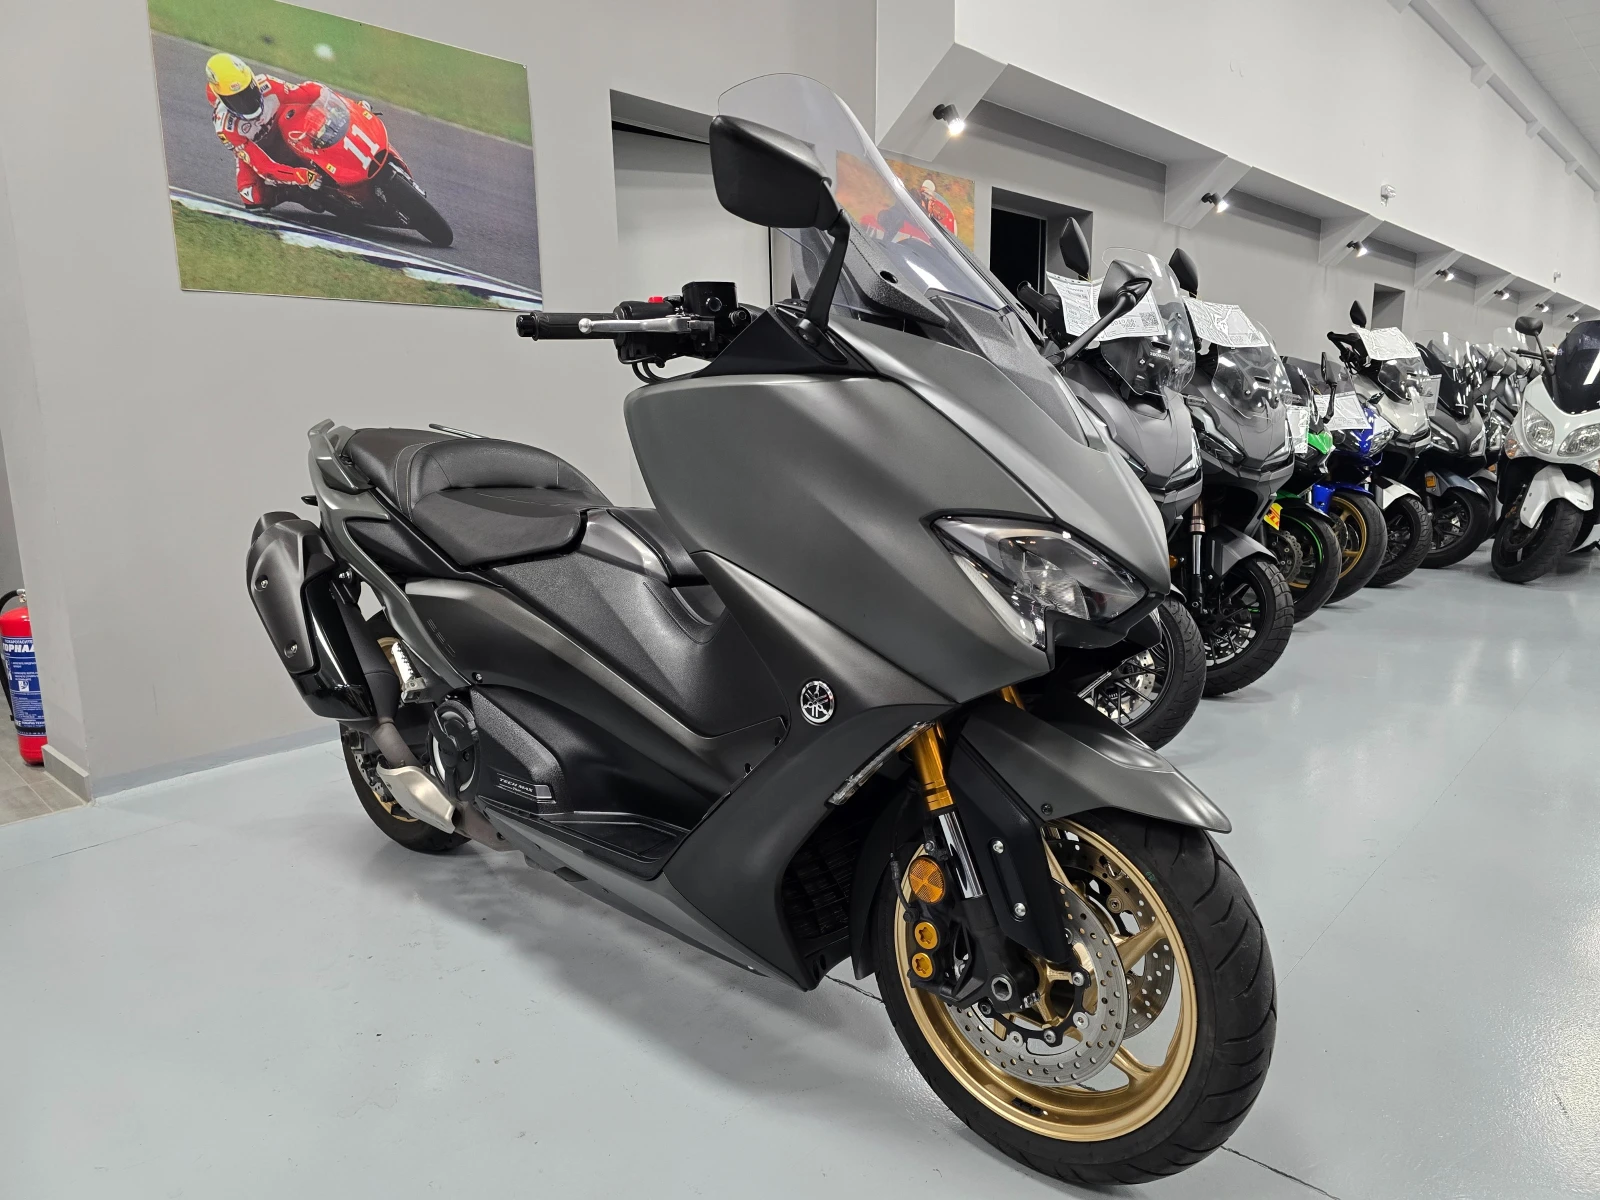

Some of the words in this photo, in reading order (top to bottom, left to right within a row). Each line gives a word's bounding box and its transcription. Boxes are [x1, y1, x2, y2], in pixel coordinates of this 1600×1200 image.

[343, 123, 380, 170] 11
[500, 778, 518, 787] TECH
[518, 784, 533, 792] MAX
